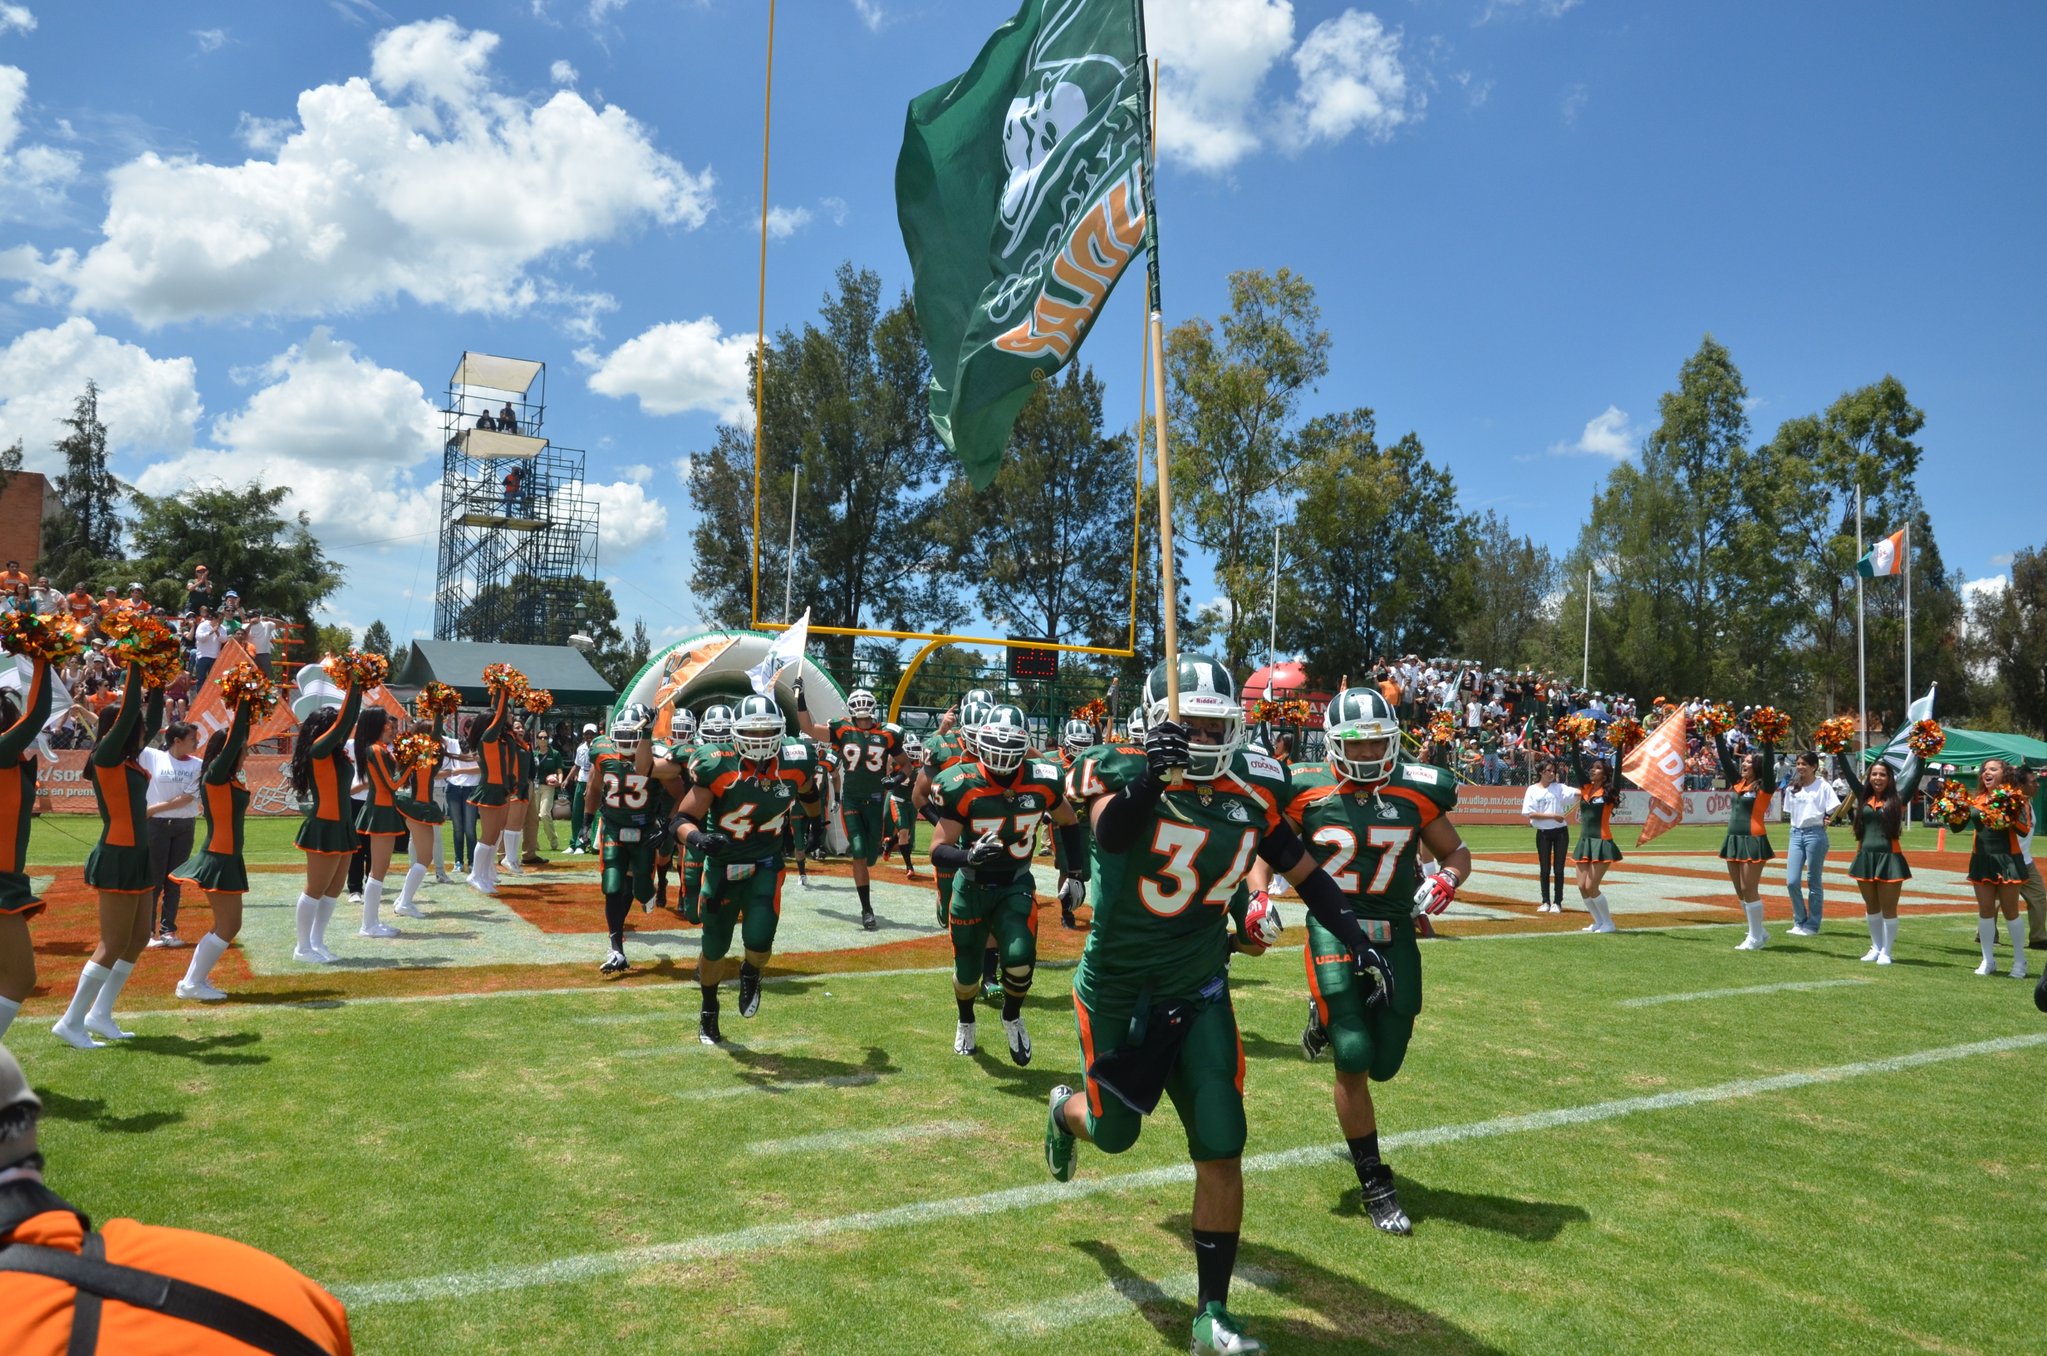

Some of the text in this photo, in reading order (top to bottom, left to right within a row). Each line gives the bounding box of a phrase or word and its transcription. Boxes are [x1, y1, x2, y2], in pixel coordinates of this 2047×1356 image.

[1196, 697, 1217, 705] Riddell
[843, 743, 885, 772] 93
[51, 788, 64, 796] en
[66, 788, 96, 798] prem
[602, 771, 649, 809] 23
[719, 799, 796, 841] 44
[1138, 818, 1259, 918] 34
[1312, 825, 1414, 894] 27
